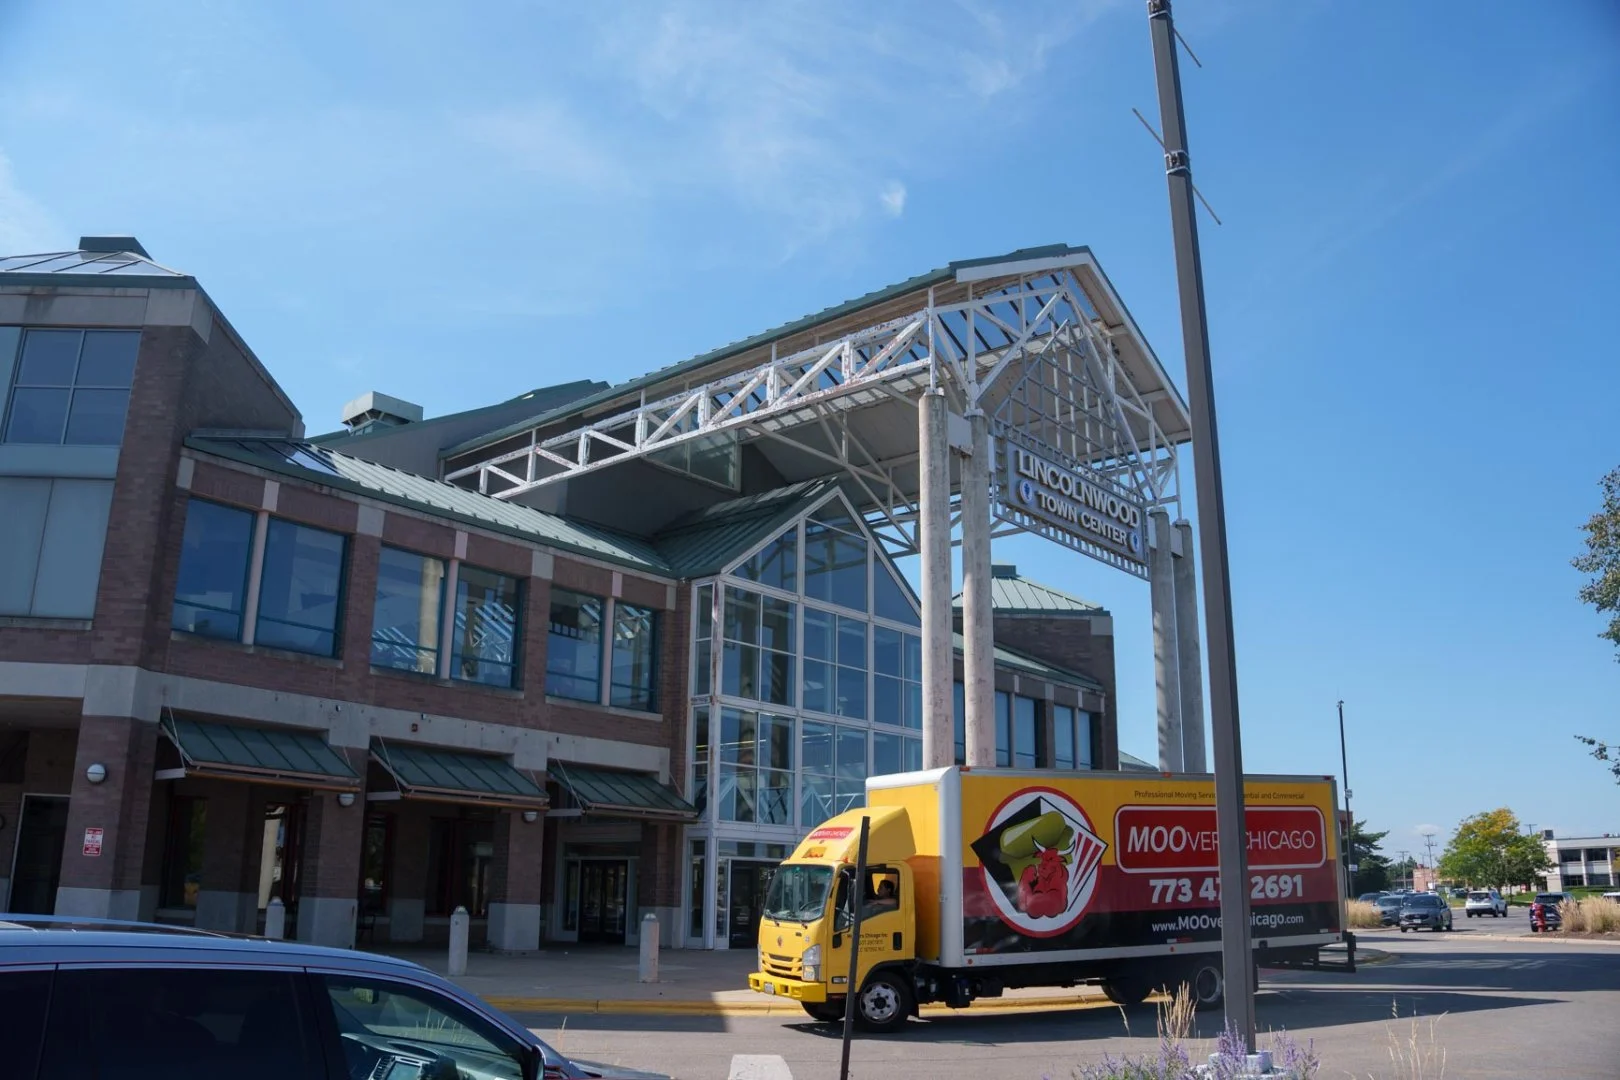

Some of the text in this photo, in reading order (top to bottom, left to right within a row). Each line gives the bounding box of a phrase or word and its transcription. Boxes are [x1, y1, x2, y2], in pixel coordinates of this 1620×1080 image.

[1017, 449, 1139, 528] LINCOLNWOOD
[1037, 491, 1127, 546] TOWN CENTER
[1134, 790, 1173, 799] Professional
[1175, 791, 1197, 800] Moving
[1273, 792, 1304, 800] Commercial
[1127, 825, 1219, 853] MOOVER
[1149, 878, 1193, 904] 773
[1250, 874, 1303, 899] 2691
